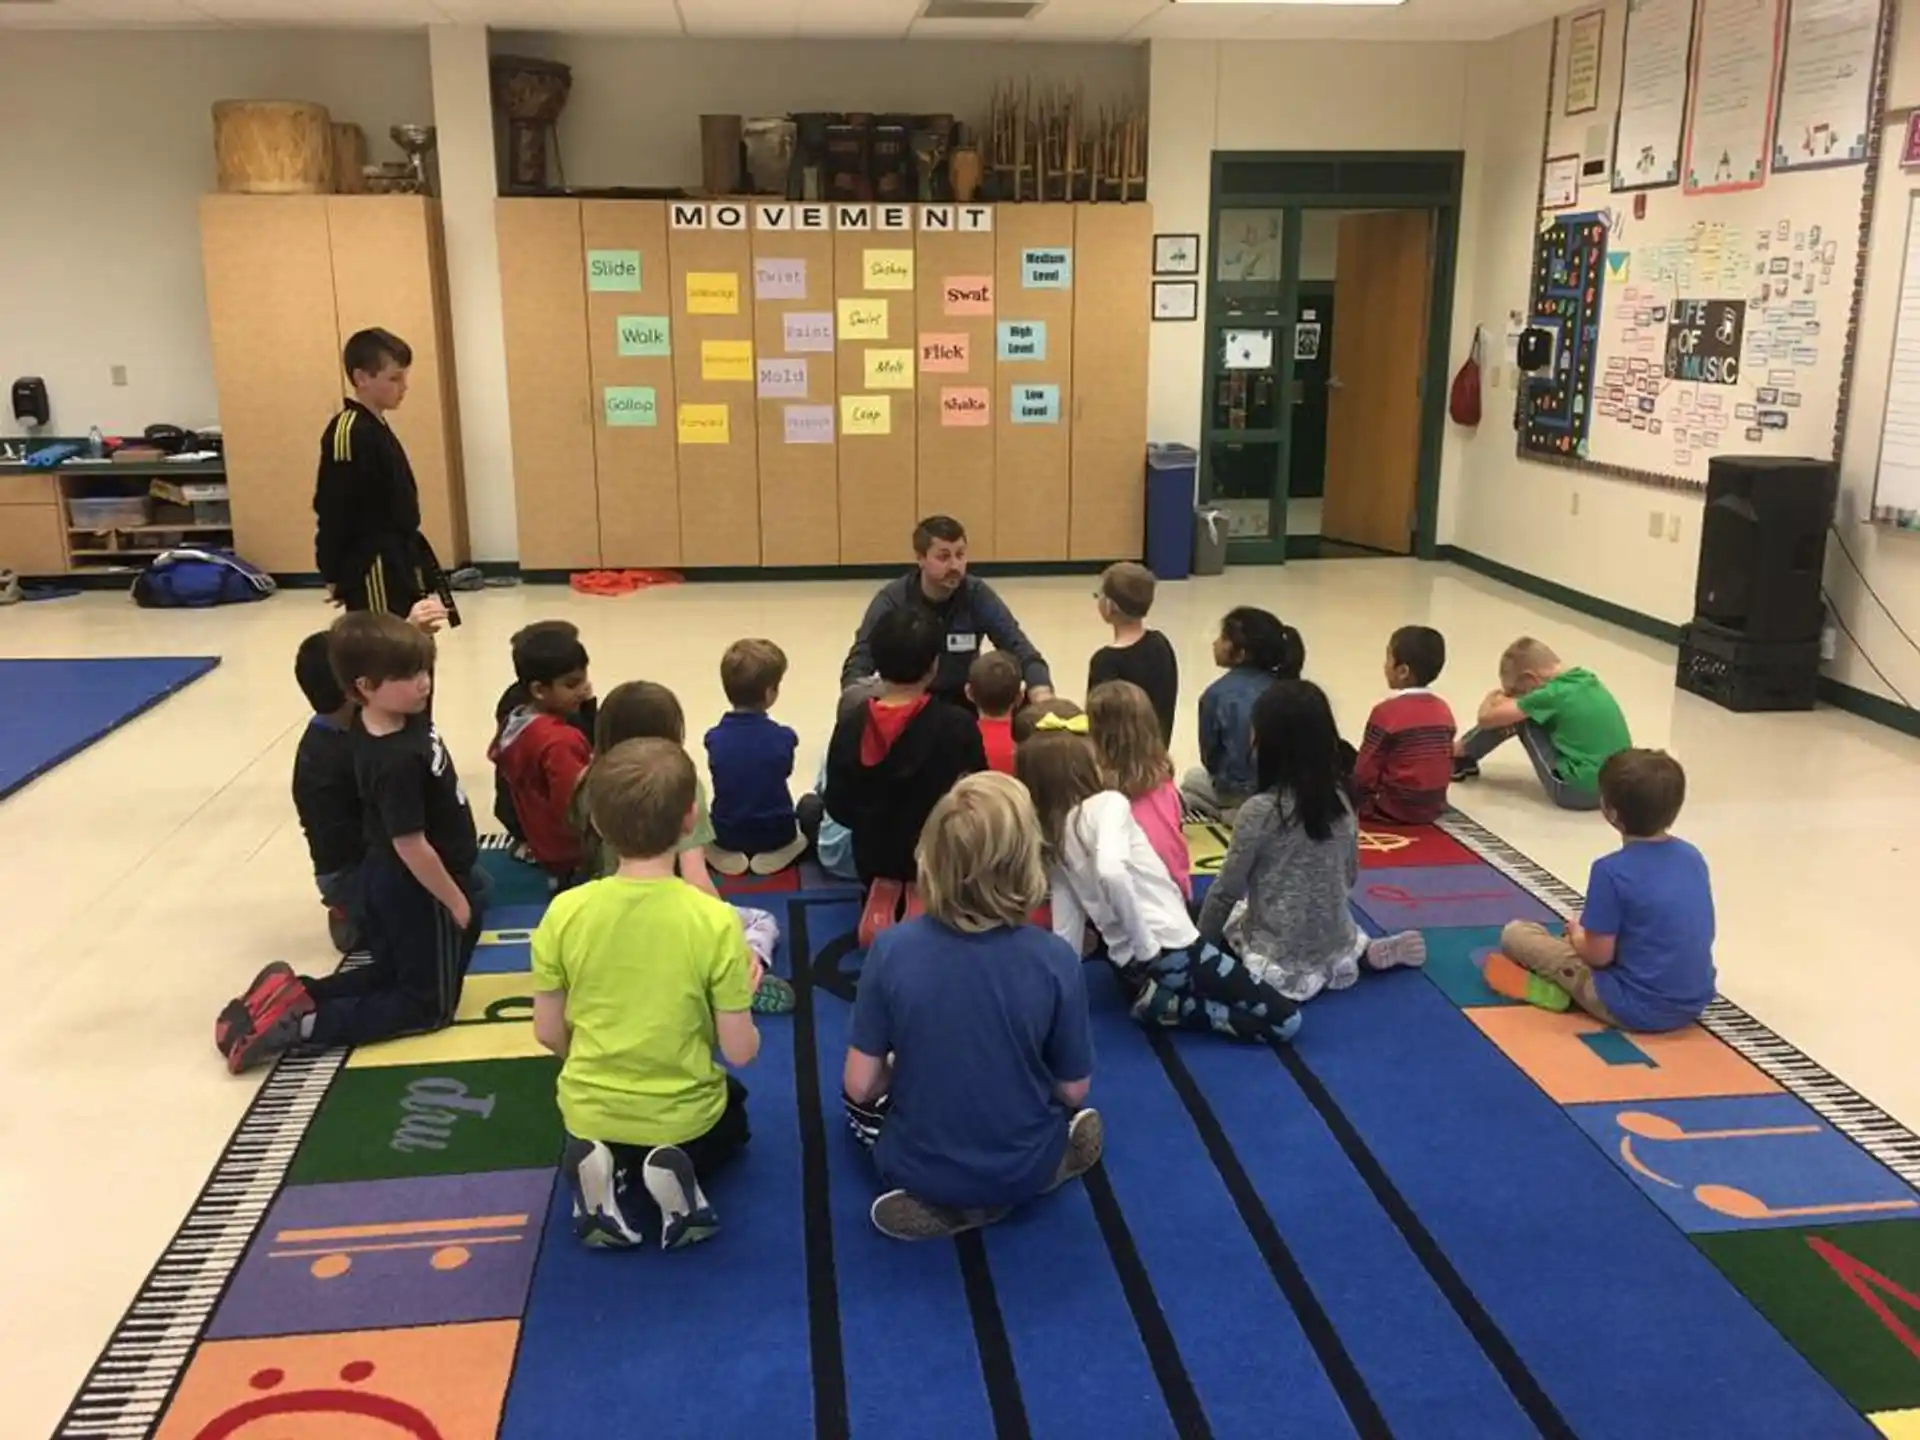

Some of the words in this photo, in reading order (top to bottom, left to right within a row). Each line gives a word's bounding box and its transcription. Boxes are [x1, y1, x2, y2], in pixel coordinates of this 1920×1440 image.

[675, 206, 984, 228] MOVEMENT
[592, 260, 636, 276] Slide
[1033, 270, 1060, 282] Level
[947, 286, 990, 302] Swat
[1671, 300, 1708, 325] LIFE
[621, 328, 664, 344] Walk
[1678, 329, 1702, 354] OF
[923, 344, 964, 360] Flick
[1681, 356, 1737, 384] MUSIC
[1025, 389, 1044, 401] Low
[607, 398, 654, 412] Gallop
[1022, 406, 1048, 417] Level
